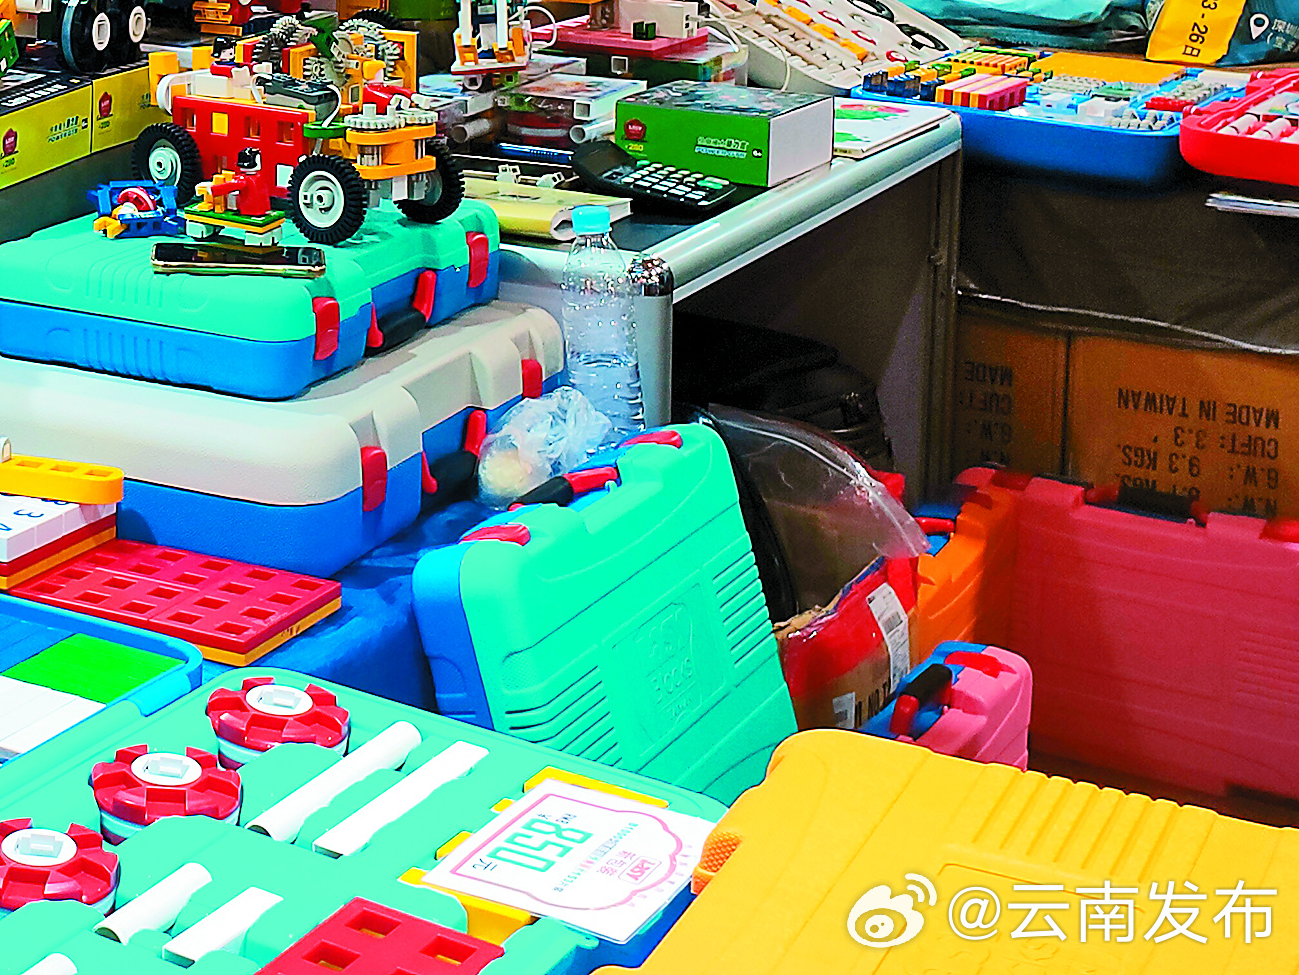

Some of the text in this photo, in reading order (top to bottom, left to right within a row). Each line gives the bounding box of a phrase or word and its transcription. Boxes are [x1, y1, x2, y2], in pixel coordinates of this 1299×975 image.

[964, 361, 1013, 386] MADE
[1117, 387, 1280, 430] MADE IN TAIWAN
[1220, 432, 1279, 460] CUFT:
[485, 817, 594, 874] 850
